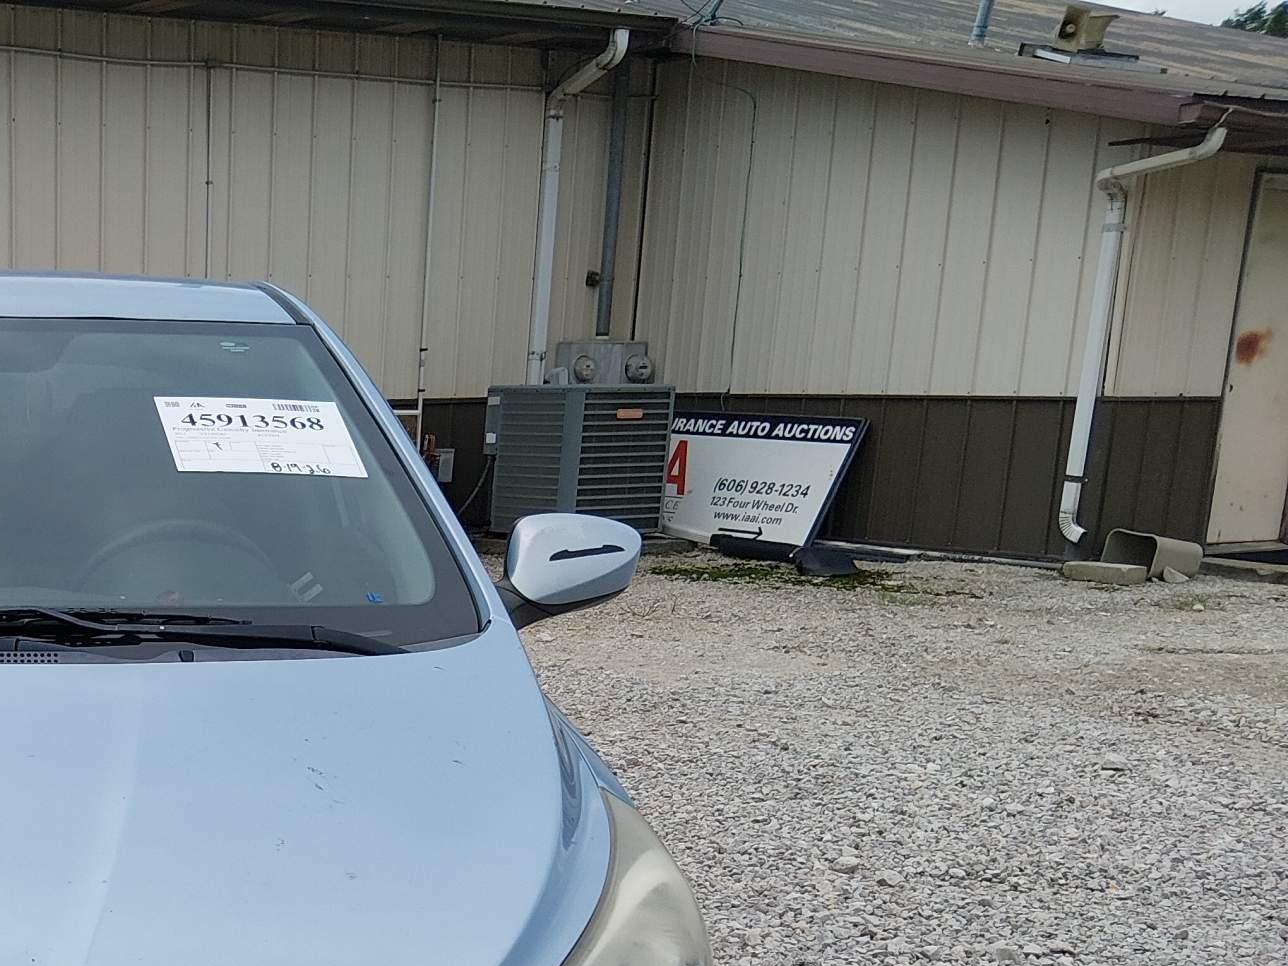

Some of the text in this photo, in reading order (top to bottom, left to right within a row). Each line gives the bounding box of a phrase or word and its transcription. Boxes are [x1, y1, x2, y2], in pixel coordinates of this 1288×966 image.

[181, 413, 325, 431] 45913568
[726, 420, 770, 437] AUTO
[772, 423, 856, 441] AUCTIONS
[714, 478, 812, 499] (606) 928-1234
[709, 496, 800, 514] 123 Four Wheel Dr.
[713, 511, 783, 525] www.iaai.com
